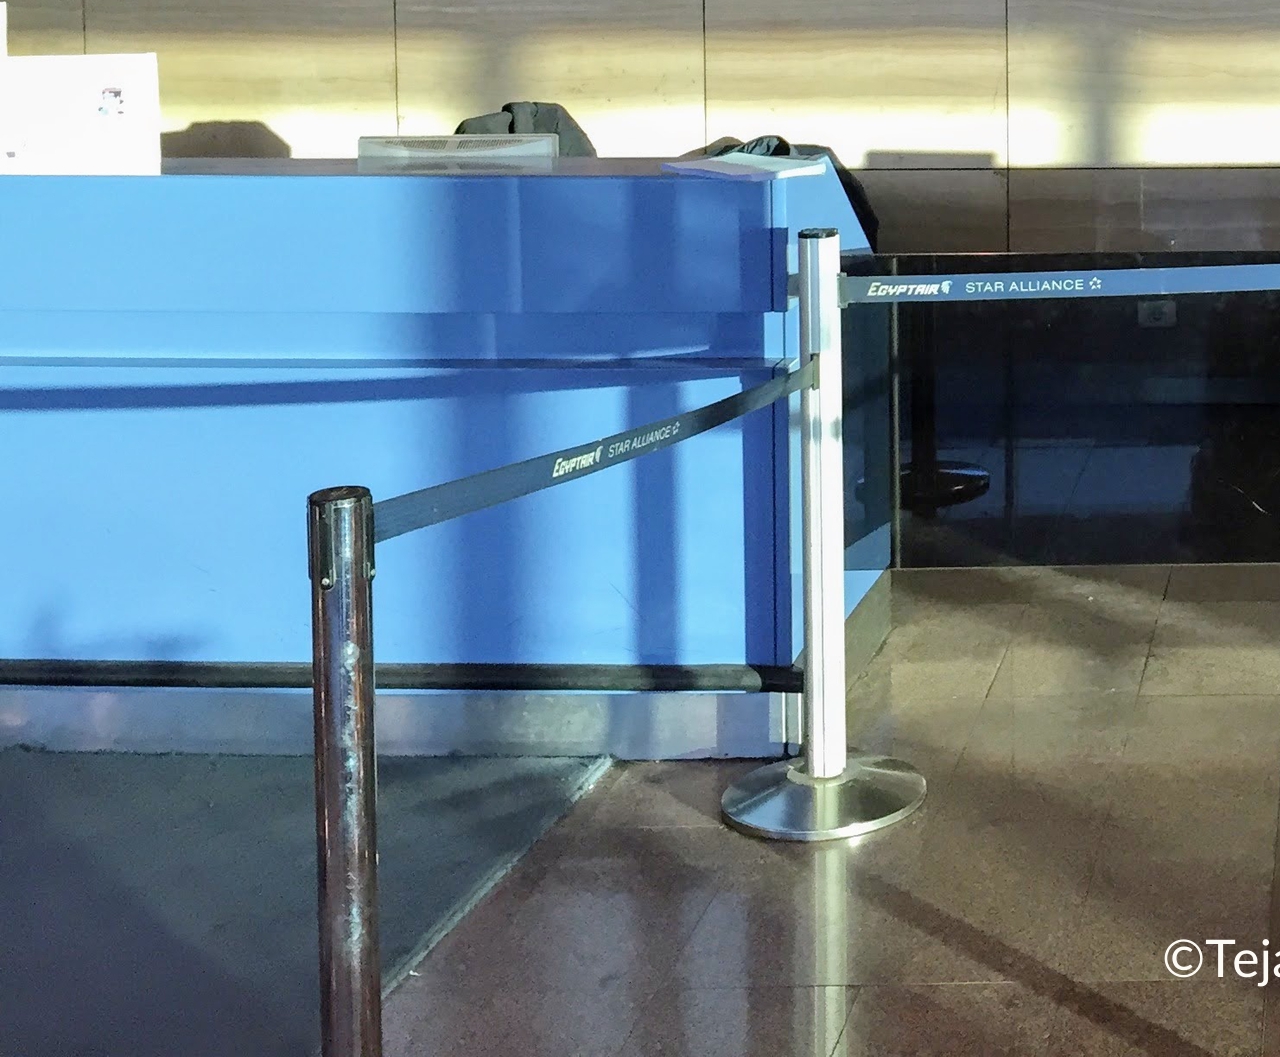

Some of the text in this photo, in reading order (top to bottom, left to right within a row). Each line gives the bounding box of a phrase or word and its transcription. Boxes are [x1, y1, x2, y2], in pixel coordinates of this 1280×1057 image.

[866, 279, 1084, 297] EGYPTAIR STAR ALLIANCE
[552, 426, 671, 478] EGYPTAIR STAR ALLIANCE
